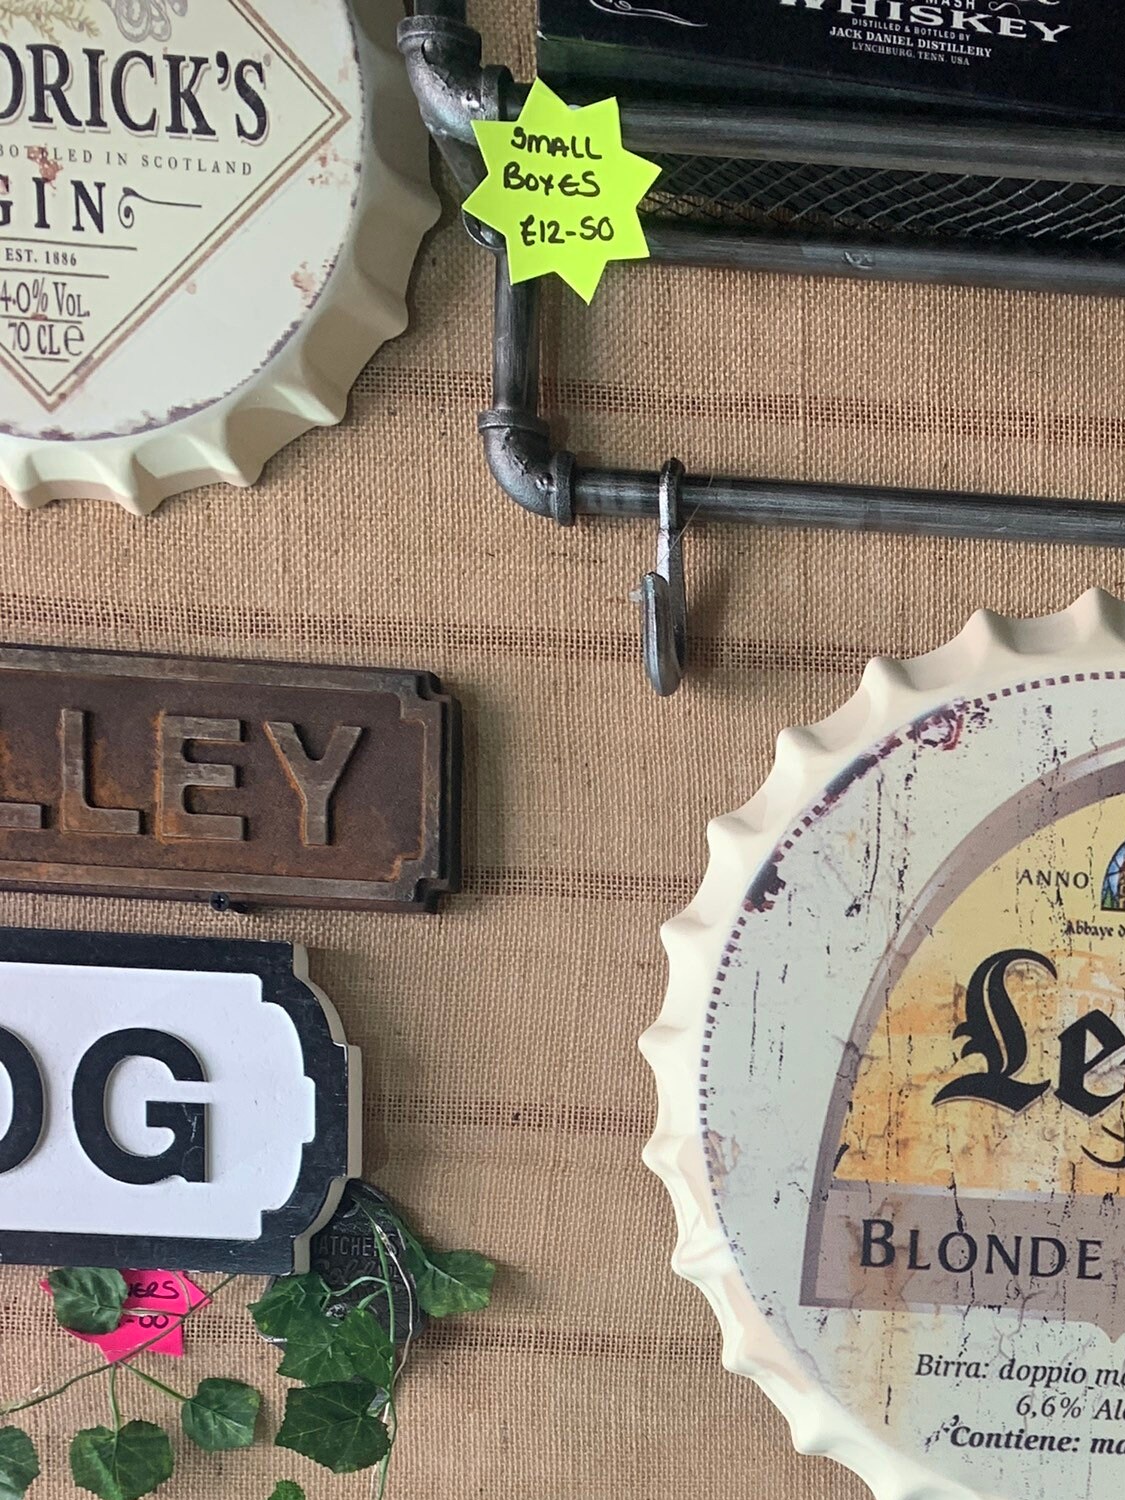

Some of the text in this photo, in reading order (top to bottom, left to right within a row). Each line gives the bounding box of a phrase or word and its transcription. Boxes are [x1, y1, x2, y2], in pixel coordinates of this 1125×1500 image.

[829, 26, 993, 58] JACK DANIEL DISTILLERY
[851, 17, 971, 42] DISTILLED & BOTTLED BY
[951, 54, 971, 67] USA
[511, 126, 603, 160] SMALL
[106, 151, 128, 166] IN
[141, 154, 253, 177] SCOTLAND
[503, 161, 601, 198] BOXES
[5, 248, 77, 266] EST. 1886
[8, 321, 31, 352] 70
[1017, 868, 1089, 889] ANNO
[1064, 920, 1114, 939] Abbaye
[859, 1218, 1103, 1281] BLONDE
[915, 1353, 990, 1379] Birra:
[998, 1357, 1088, 1390] doppio
[1016, 1394, 1083, 1422] 6,6%
[949, 1425, 1079, 1454] Contiene:
